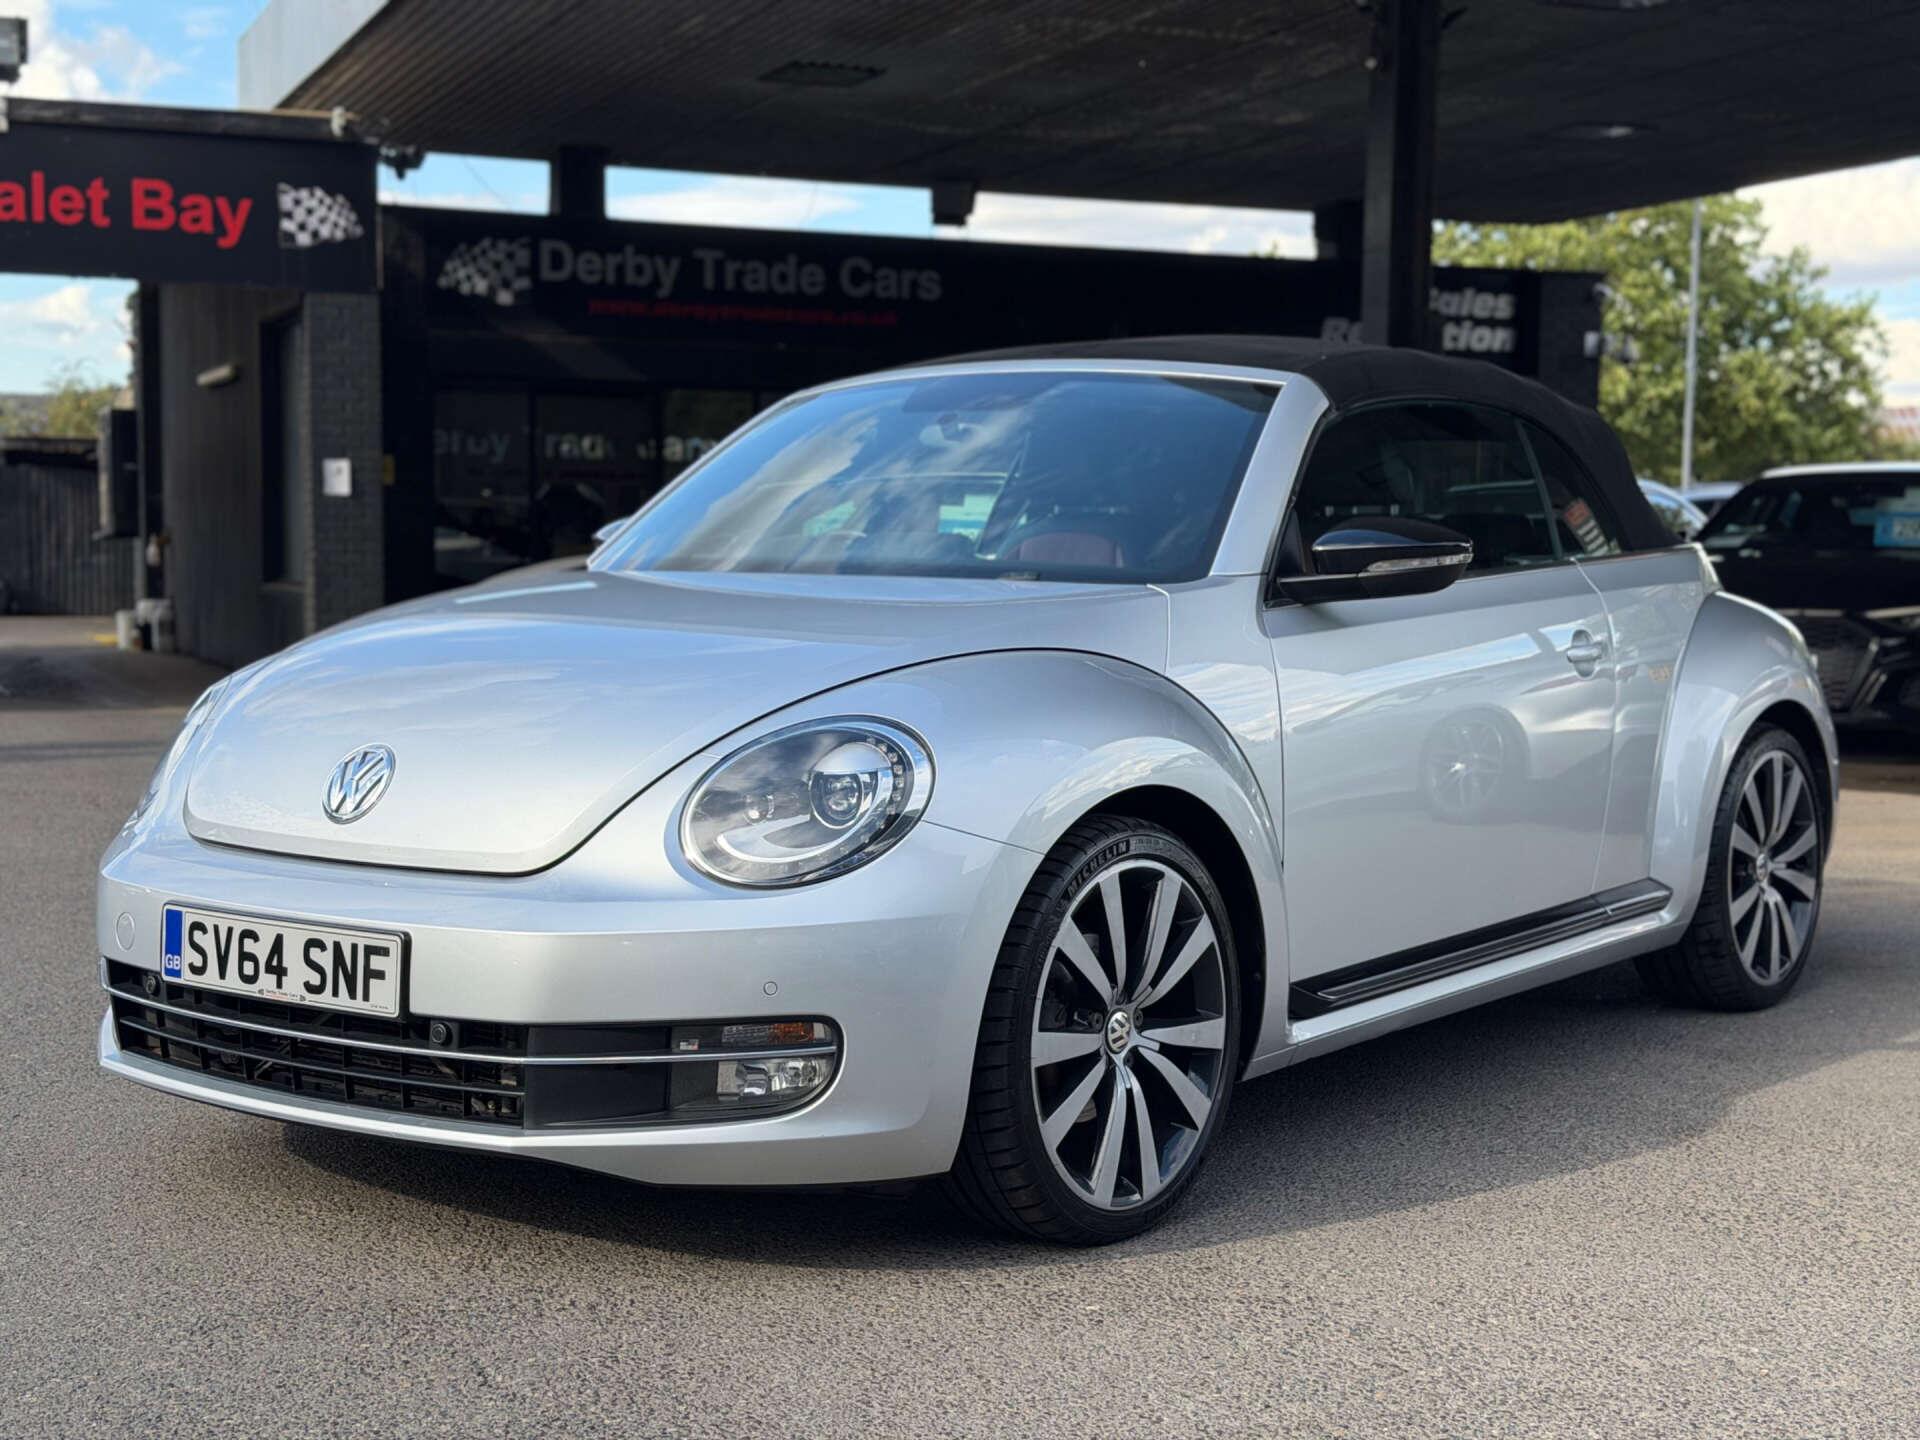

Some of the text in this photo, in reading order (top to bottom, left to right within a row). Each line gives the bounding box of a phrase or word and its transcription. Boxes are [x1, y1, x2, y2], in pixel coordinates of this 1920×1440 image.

[131, 177, 253, 249] Bay
[538, 239, 942, 300] Derby Trade Cars
[1066, 838, 1129, 897] MICHELIN
[164, 954, 181, 971] GB
[187, 920, 390, 1002] SV64 SNF
